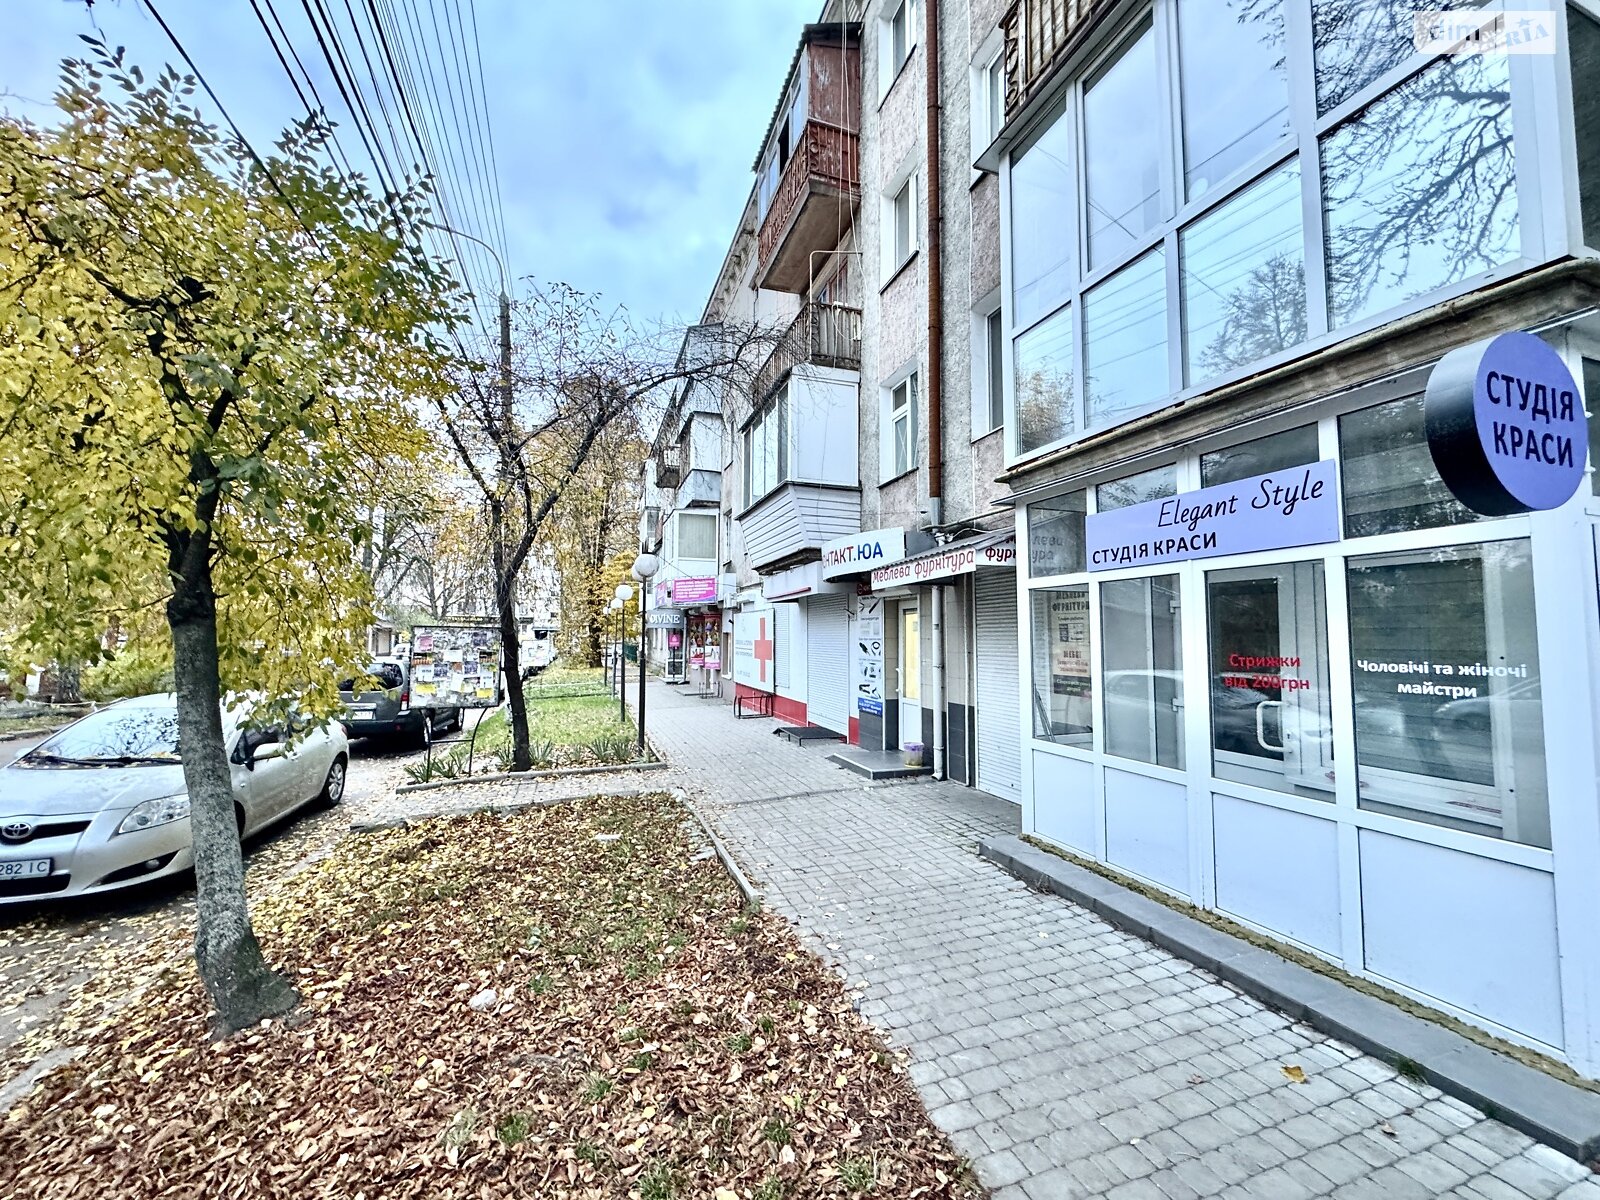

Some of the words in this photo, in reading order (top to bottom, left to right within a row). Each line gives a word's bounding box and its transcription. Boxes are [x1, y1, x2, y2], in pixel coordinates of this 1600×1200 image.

[1487, 371, 1574, 424] СТУДІЯ
[1493, 421, 1573, 468] КРАСИ
[1157, 495, 1239, 532] Elegant
[1251, 470, 1324, 515] Style
[1092, 542, 1149, 567] СТУДІЯ
[1153, 531, 1217, 557] КРАСИ
[649, 614, 681, 624] DIVINE
[1228, 653, 1301, 671] Стрижки
[1357, 659, 1429, 674] Чоловічі
[1432, 664, 1454, 675] та
[1458, 662, 1527, 678] жіночі
[1223, 675, 1249, 689] від
[1397, 681, 1478, 699] майстри
